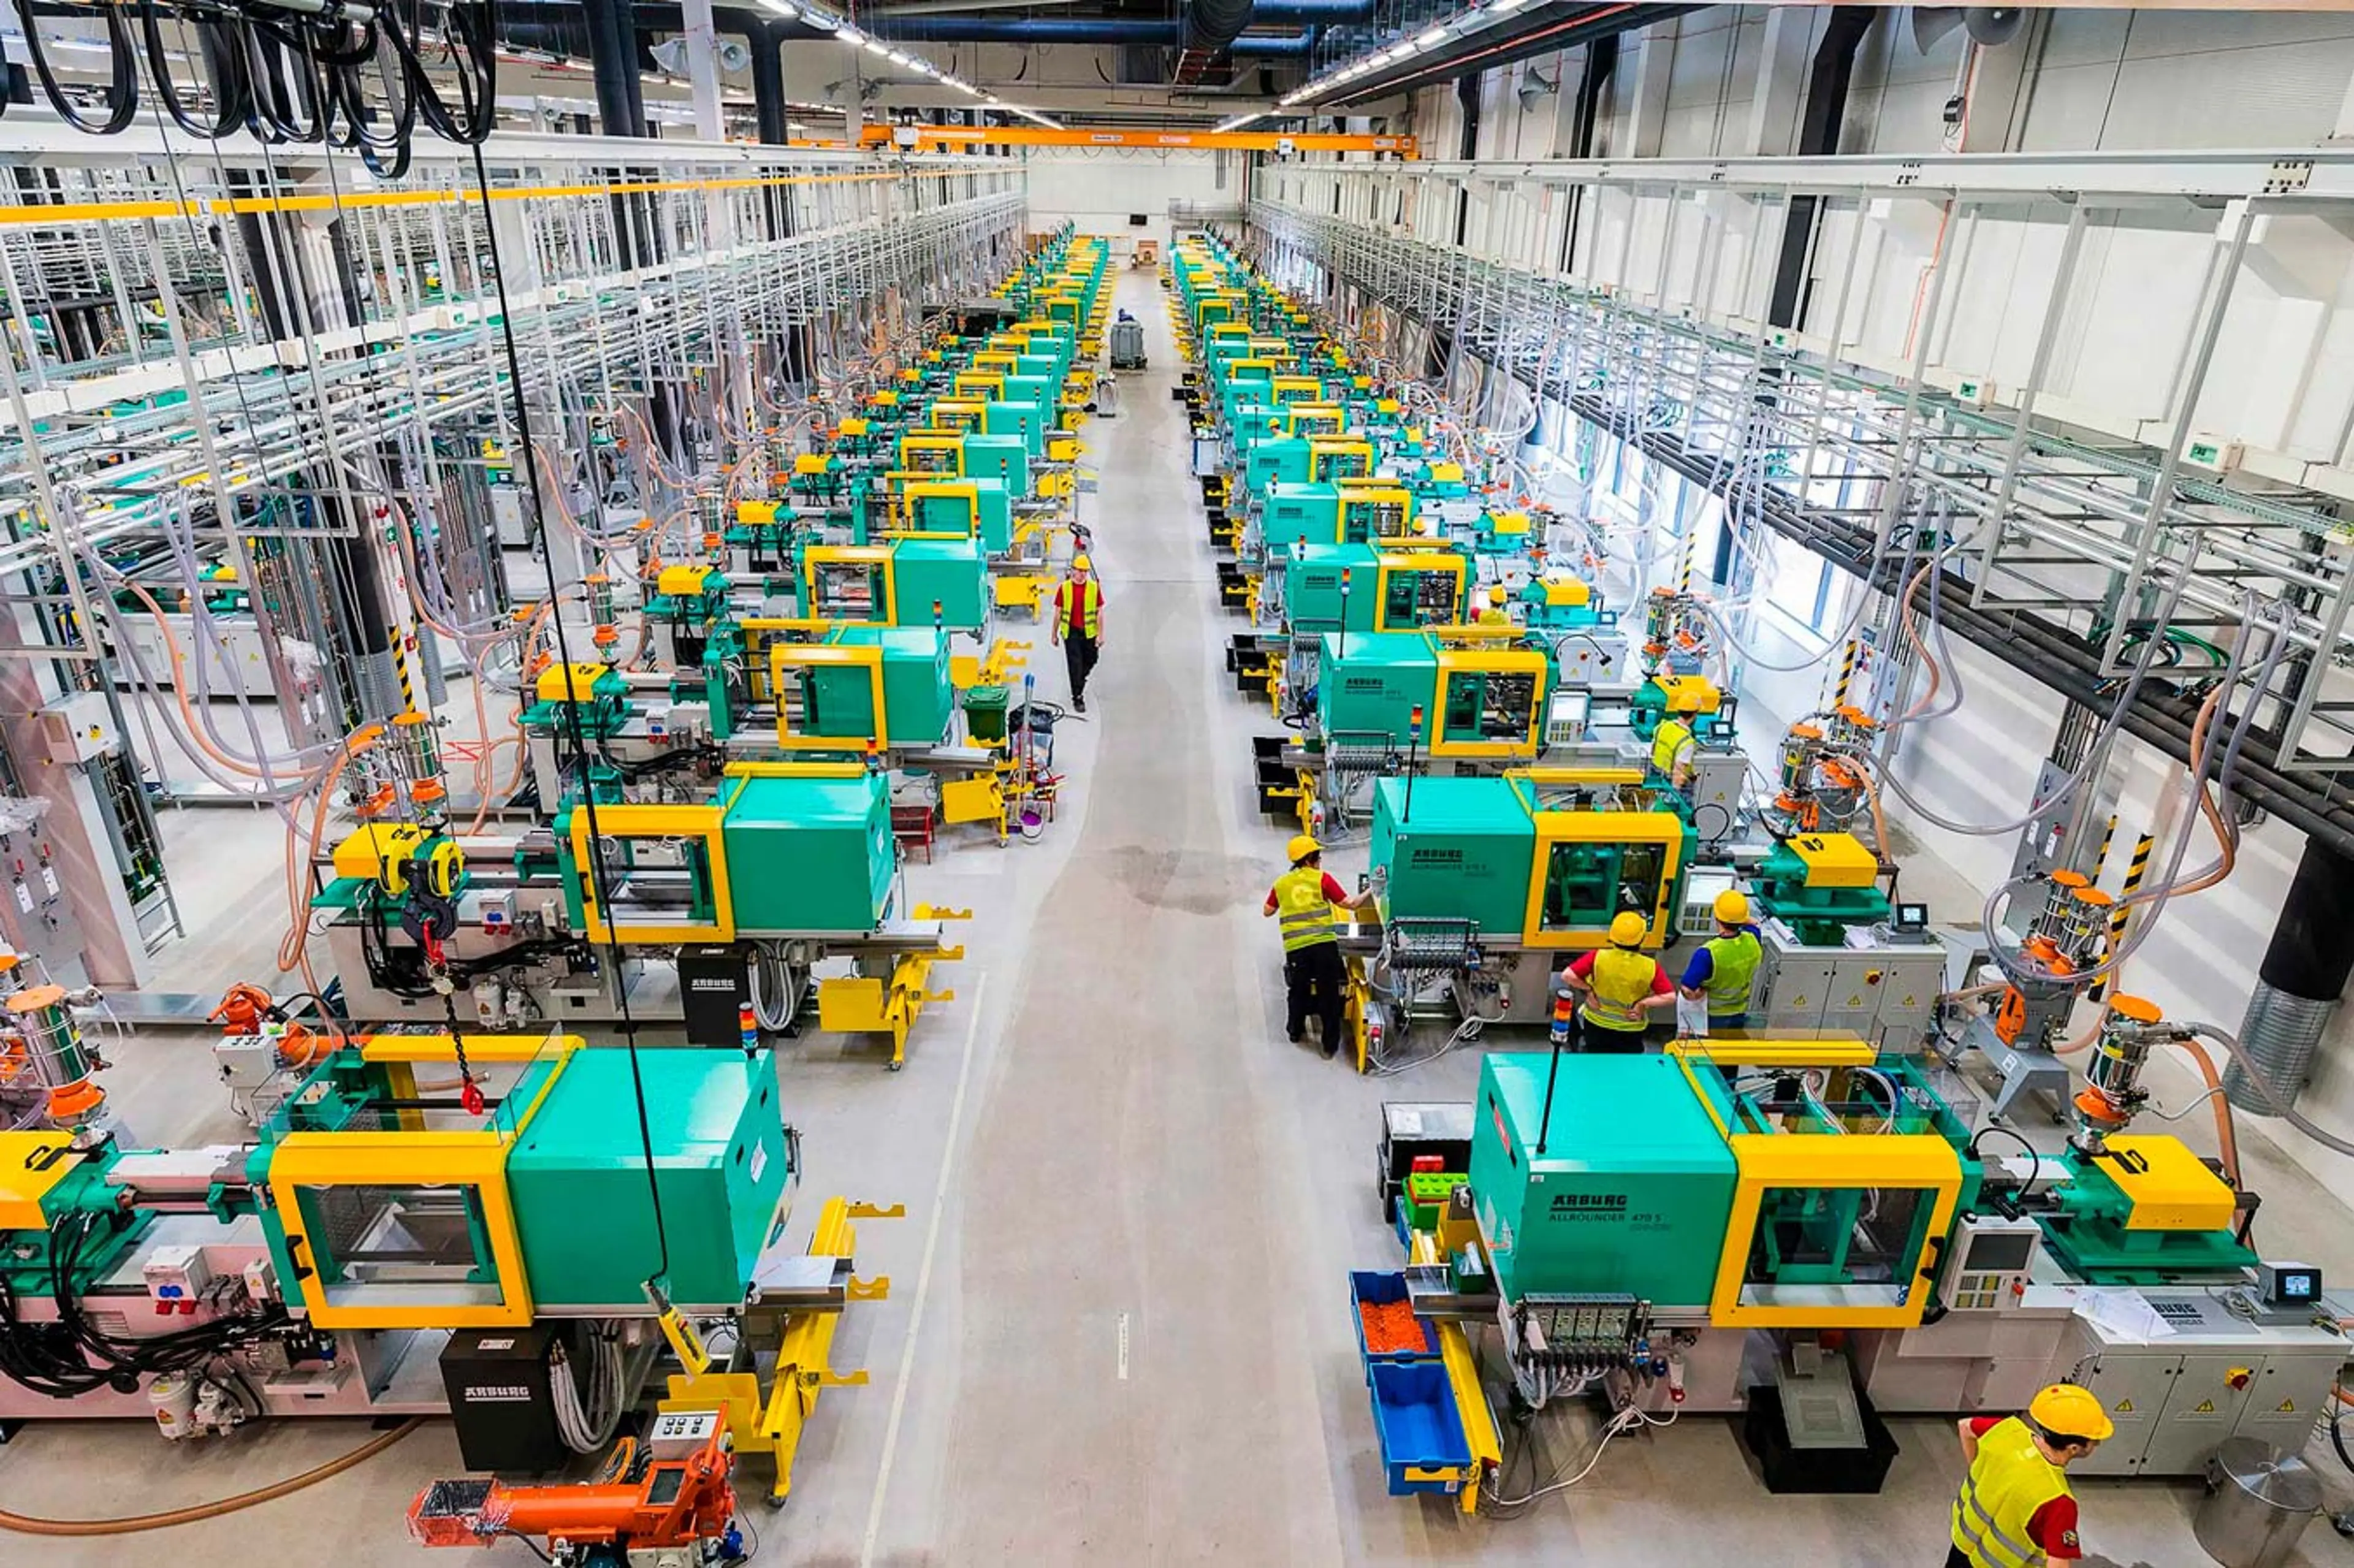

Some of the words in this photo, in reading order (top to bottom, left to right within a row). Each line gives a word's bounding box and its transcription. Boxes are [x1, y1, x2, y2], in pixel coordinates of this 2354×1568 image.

[1552, 1195, 1628, 1206] ARBURG
[1548, 1213, 1626, 1222] ALLROUNDER
[2151, 1303, 2198, 1313] BURG
[465, 1386, 530, 1398] ARBURG
